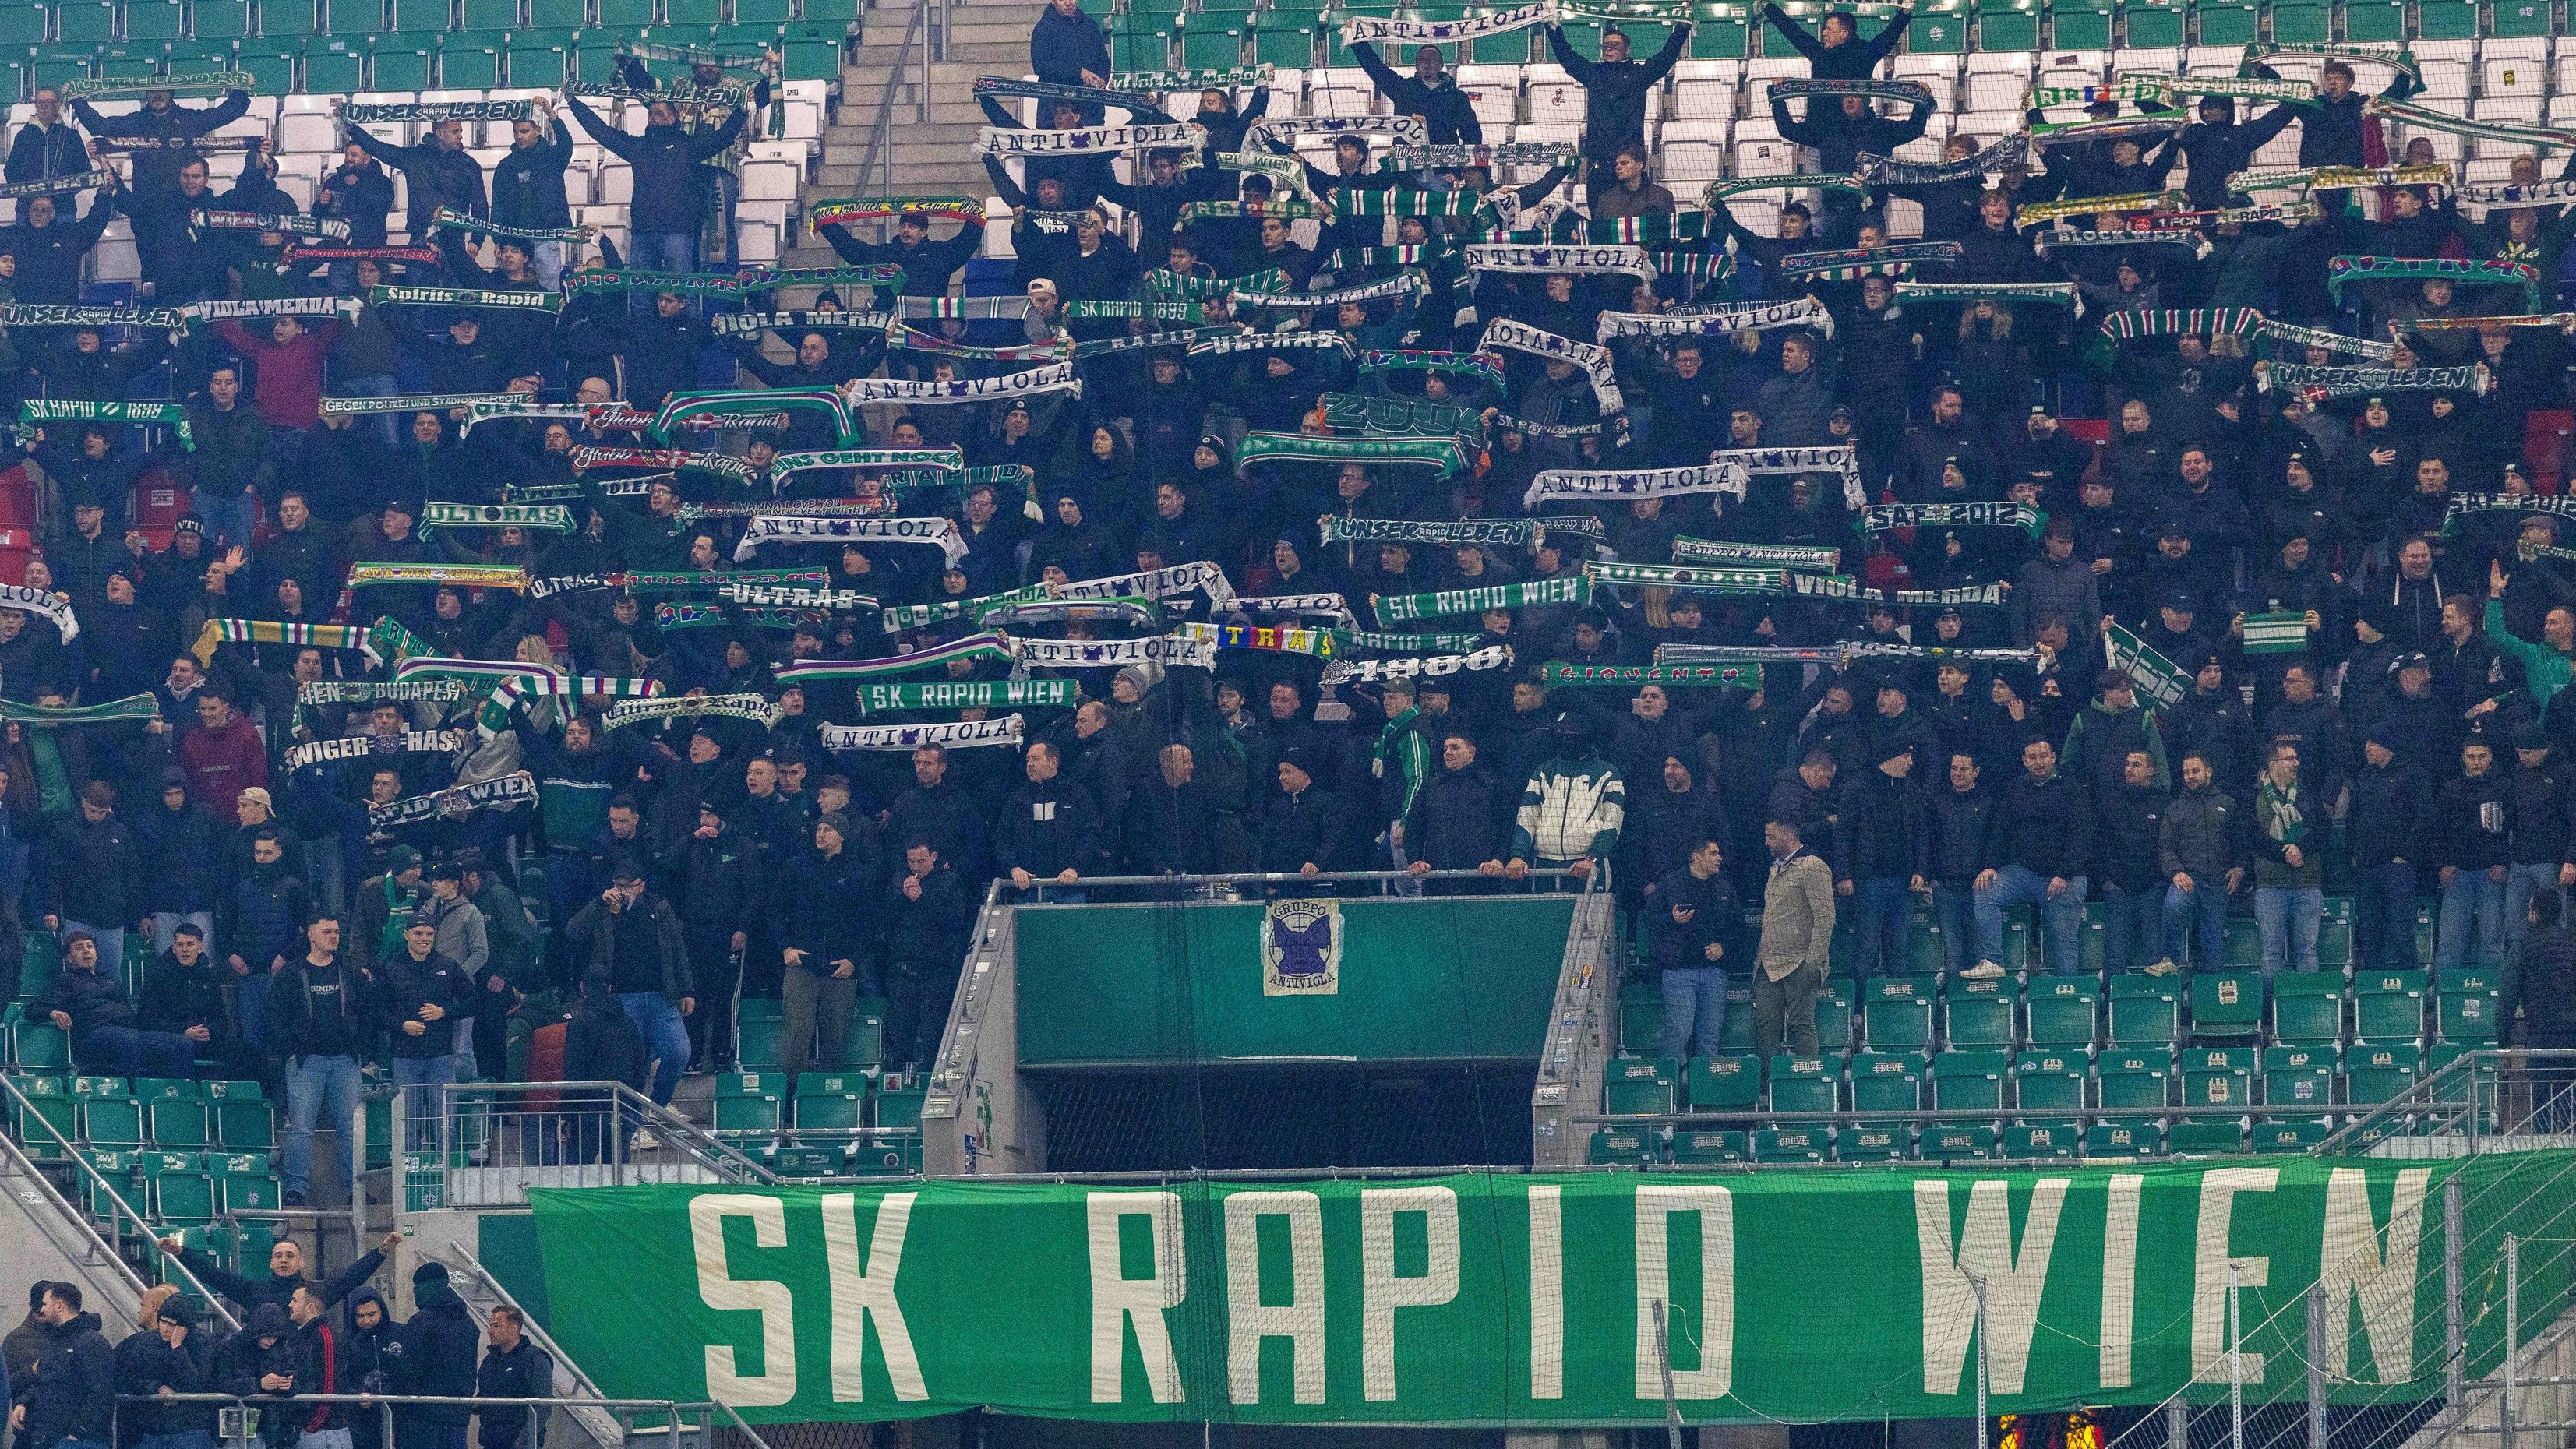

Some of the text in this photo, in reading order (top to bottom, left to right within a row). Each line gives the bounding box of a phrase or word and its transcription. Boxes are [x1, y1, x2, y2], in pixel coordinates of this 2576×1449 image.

[1353, 20, 1428, 40] ANTI
[1456, 2, 1544, 34] VIOLA
[574, 79, 739, 106] UNSER RAPID LEBEN
[347, 100, 522, 121] UNSER RAPID LEBEN
[989, 123, 1187, 152] ANTI VIOLA
[1254, 153, 1291, 171] WIEN
[1807, 175, 1845, 185] WIEN
[915, 198, 951, 215] Rapid
[2240, 207, 2282, 220] RAPID
[2058, 230, 2126, 242] BLOCK
[1554, 249, 1645, 270] VIOLA
[198, 296, 337, 319] VIOLA MERDA
[387, 287, 545, 307] Spirits Rapid
[3, 305, 182, 327] UNSER RAPID LEBEN
[1081, 300, 1187, 320] SK RAPID 1899
[1617, 302, 1822, 336] ANTI VIOLA
[1111, 329, 1197, 348] RAPID
[1213, 330, 1336, 353] ULTRAS
[863, 365, 1071, 401] ANTI VIOLA
[2278, 366, 2467, 388] UNSER RAPID LEBEN
[24, 400, 49, 418] SK
[51, 400, 95, 418] RAPID
[326, 397, 430, 411] GEGEN POLIZEI UND
[722, 411, 782, 428] Rapid
[1498, 414, 1515, 428] SK
[772, 450, 962, 478] EINS GEHT NOCH
[890, 464, 1019, 484] RAPID
[1540, 465, 1731, 494] ANTI VIOLA
[739, 498, 842, 511] WANNA LOVE YOU
[1544, 520, 1577, 531] RAPID
[1870, 502, 2019, 530] SAF 2012
[746, 520, 951, 542] ANTI VIOLA
[1340, 518, 1523, 545] UNSER RAPID LEBEN
[531, 573, 598, 599] ULTRAS
[1135, 566, 1220, 593] VIOLA
[1794, 573, 2000, 605] VIOLA MERDA
[733, 583, 856, 610] ULTRAS
[1389, 577, 1576, 621] SK RAPID WIEN
[1106, 640, 1198, 659] VIOLA
[1360, 646, 1504, 682] 1988
[873, 681, 1064, 709] SK RAPID WIEN
[706, 696, 775, 719] Rapid
[824, 719, 1010, 749] ANTI VIOLA
[1273, 900, 1327, 918] GRUPPO
[1269, 971, 1336, 990] ANTIVIOLA
[689, 1166, 2433, 1408] SK RAPID WIEN
